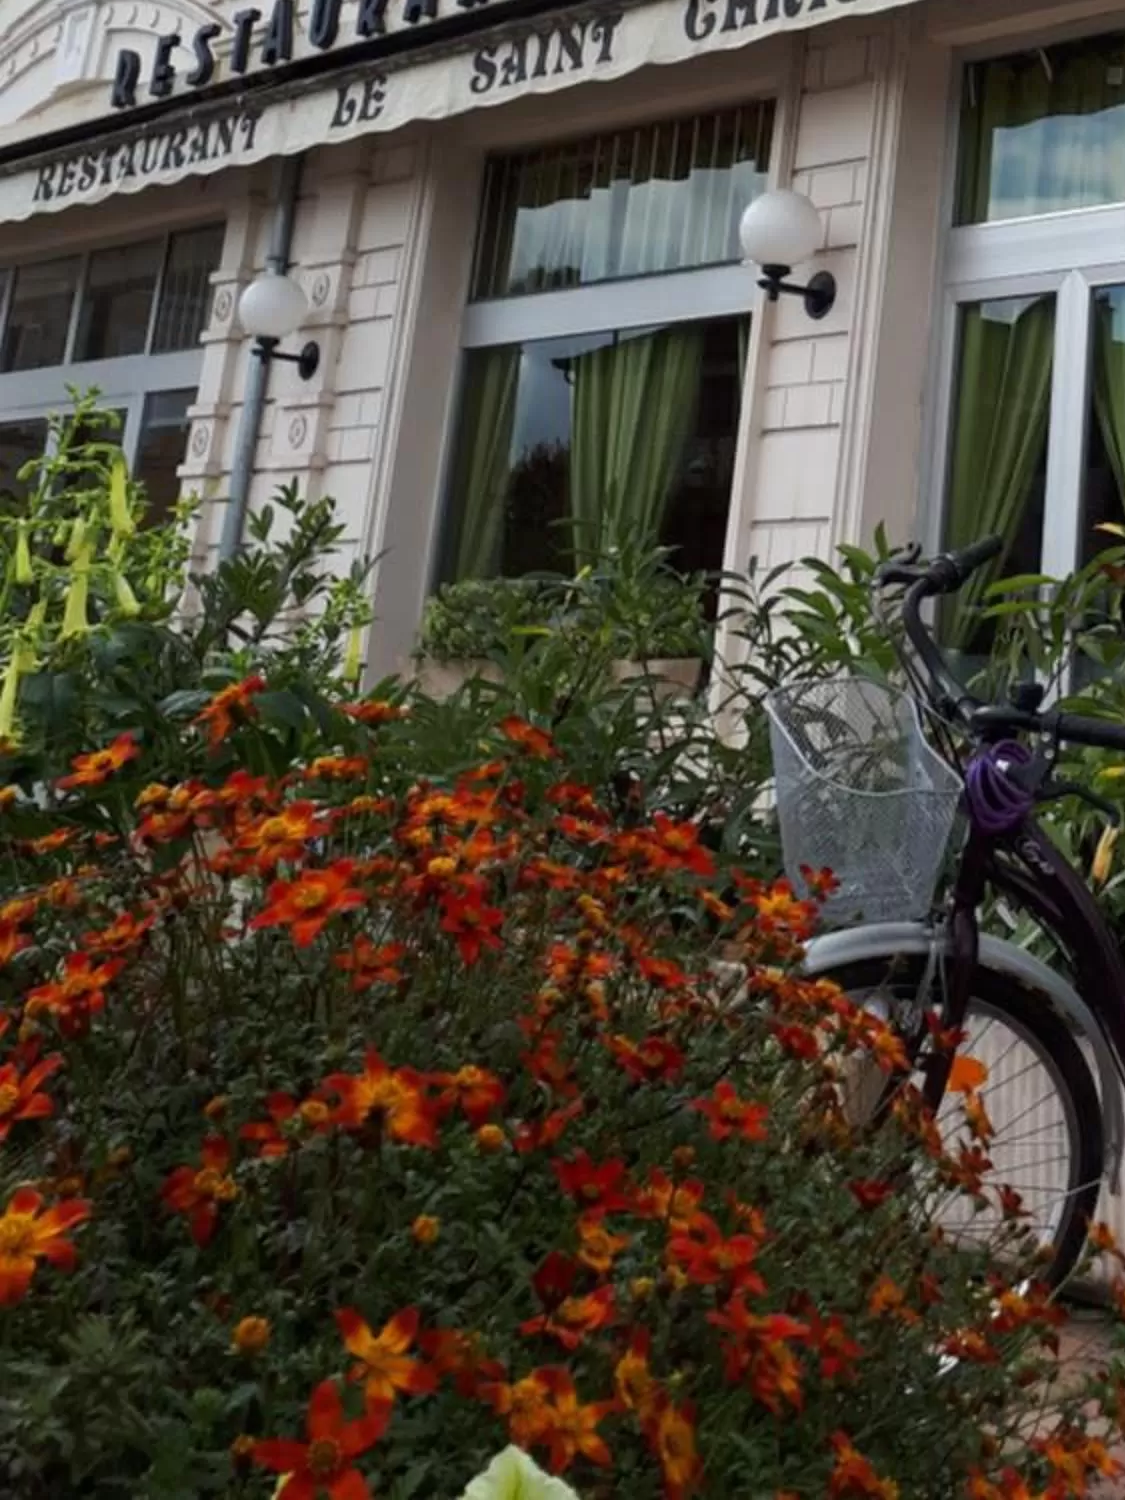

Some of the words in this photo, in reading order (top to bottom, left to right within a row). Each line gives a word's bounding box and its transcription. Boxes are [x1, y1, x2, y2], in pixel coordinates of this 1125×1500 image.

[33, 113, 262, 202] RESTAURANT
[331, 78, 387, 130] LE
[469, 17, 622, 93] SAINT
